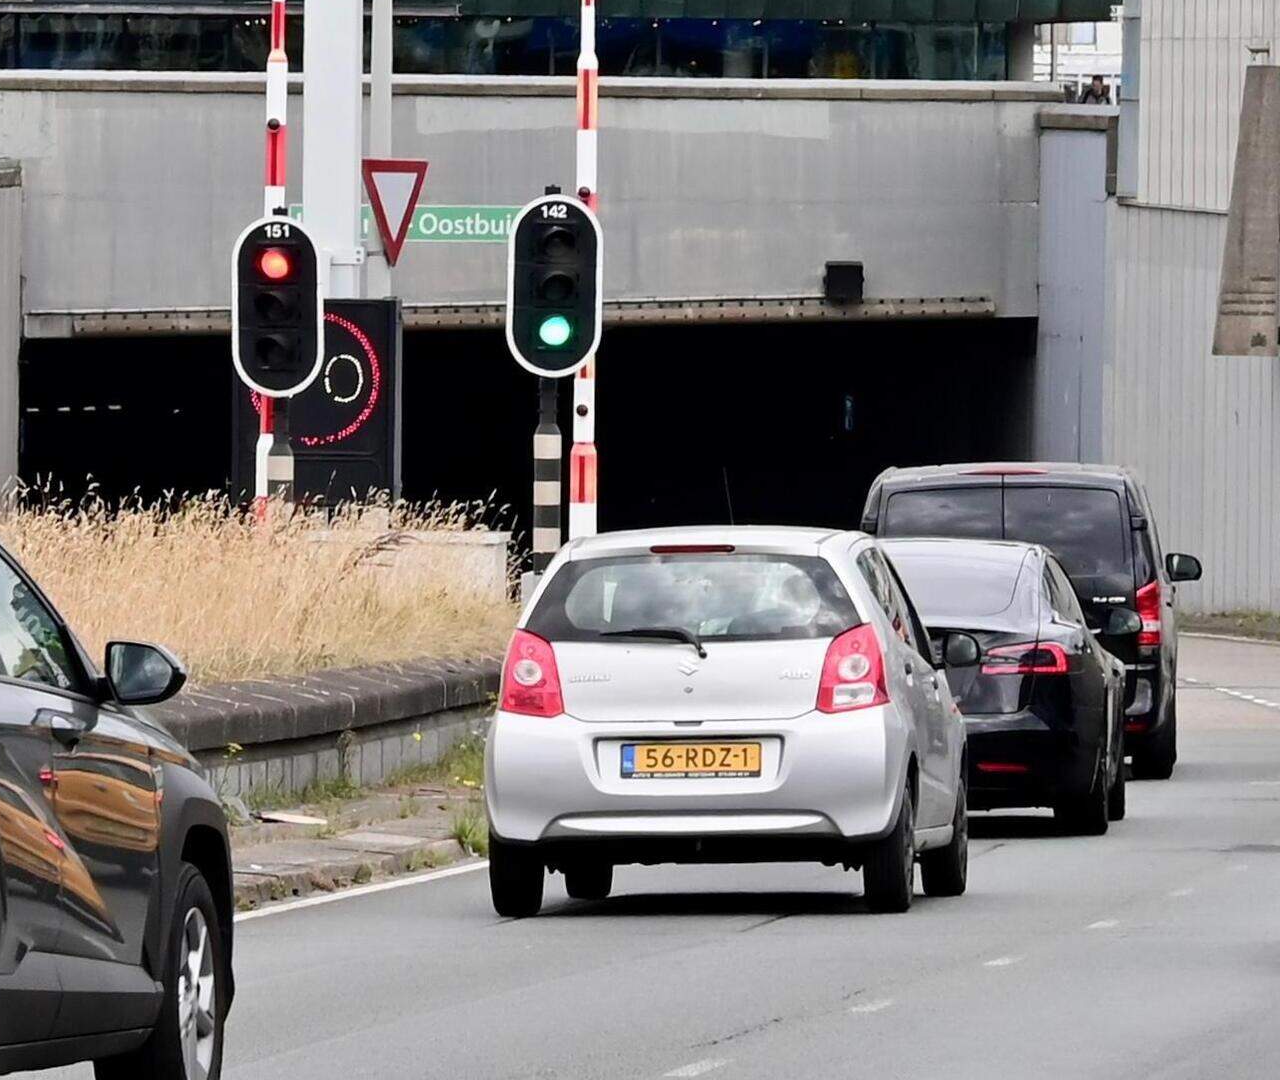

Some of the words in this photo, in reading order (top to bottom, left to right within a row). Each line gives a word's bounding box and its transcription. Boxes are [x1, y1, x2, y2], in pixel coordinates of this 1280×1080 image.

[540, 204, 568, 219] 142
[264, 224, 290, 239] 151
[418, 211, 512, 236] Oostbui
[645, 747, 749, 768] 56-RDZ-1
